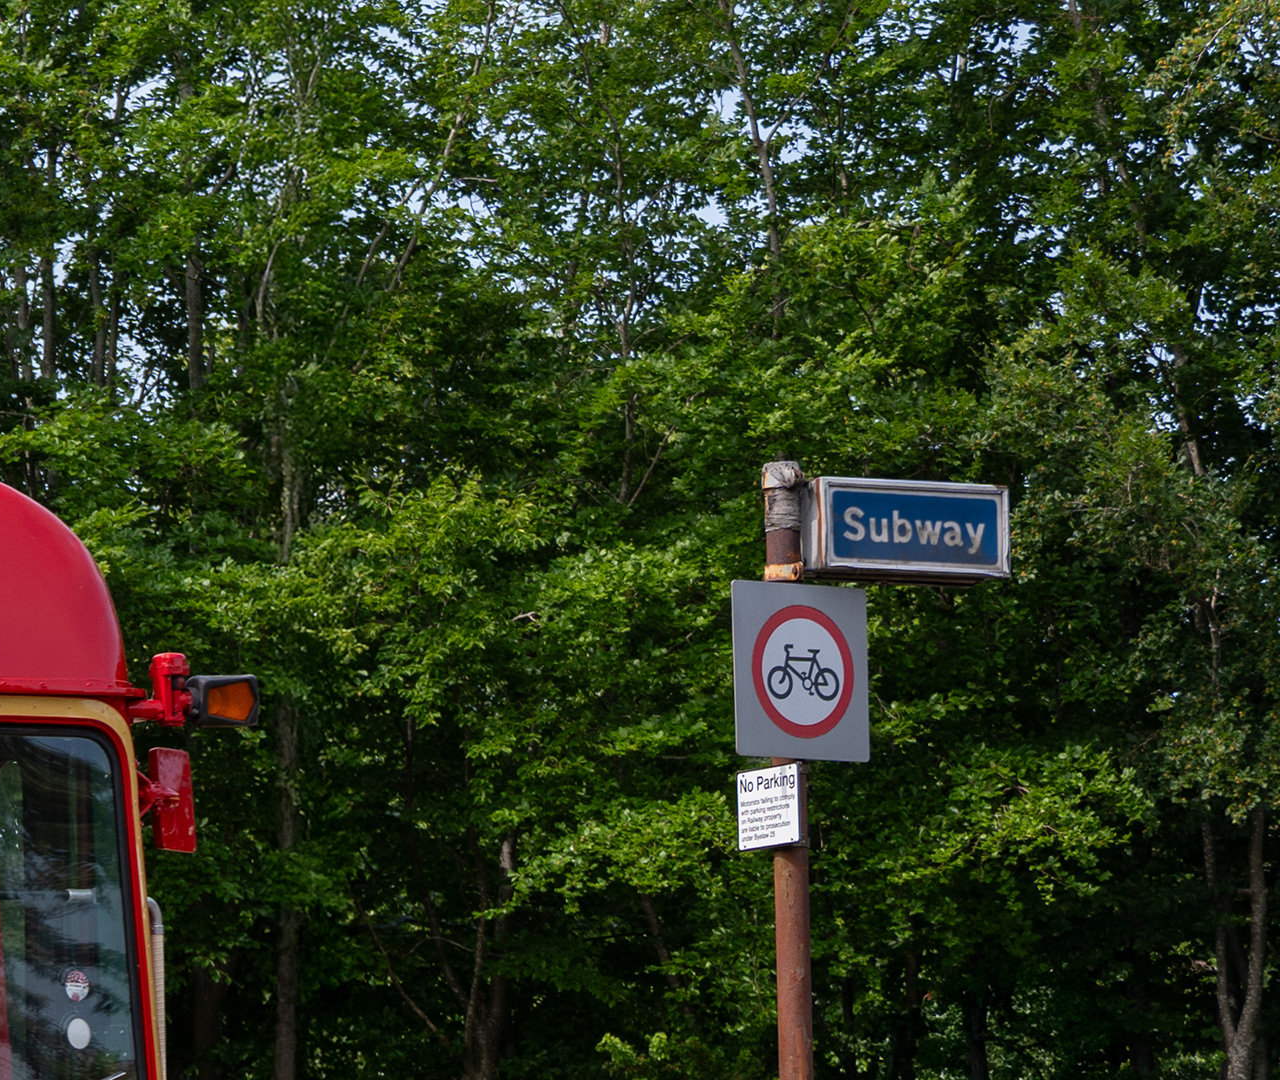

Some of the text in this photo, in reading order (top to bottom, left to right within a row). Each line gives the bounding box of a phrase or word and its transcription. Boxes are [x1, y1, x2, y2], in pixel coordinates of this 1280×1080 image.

[843, 506, 985, 555] Subway
[740, 773, 795, 794] No Parking
[750, 807, 766, 815] parking
